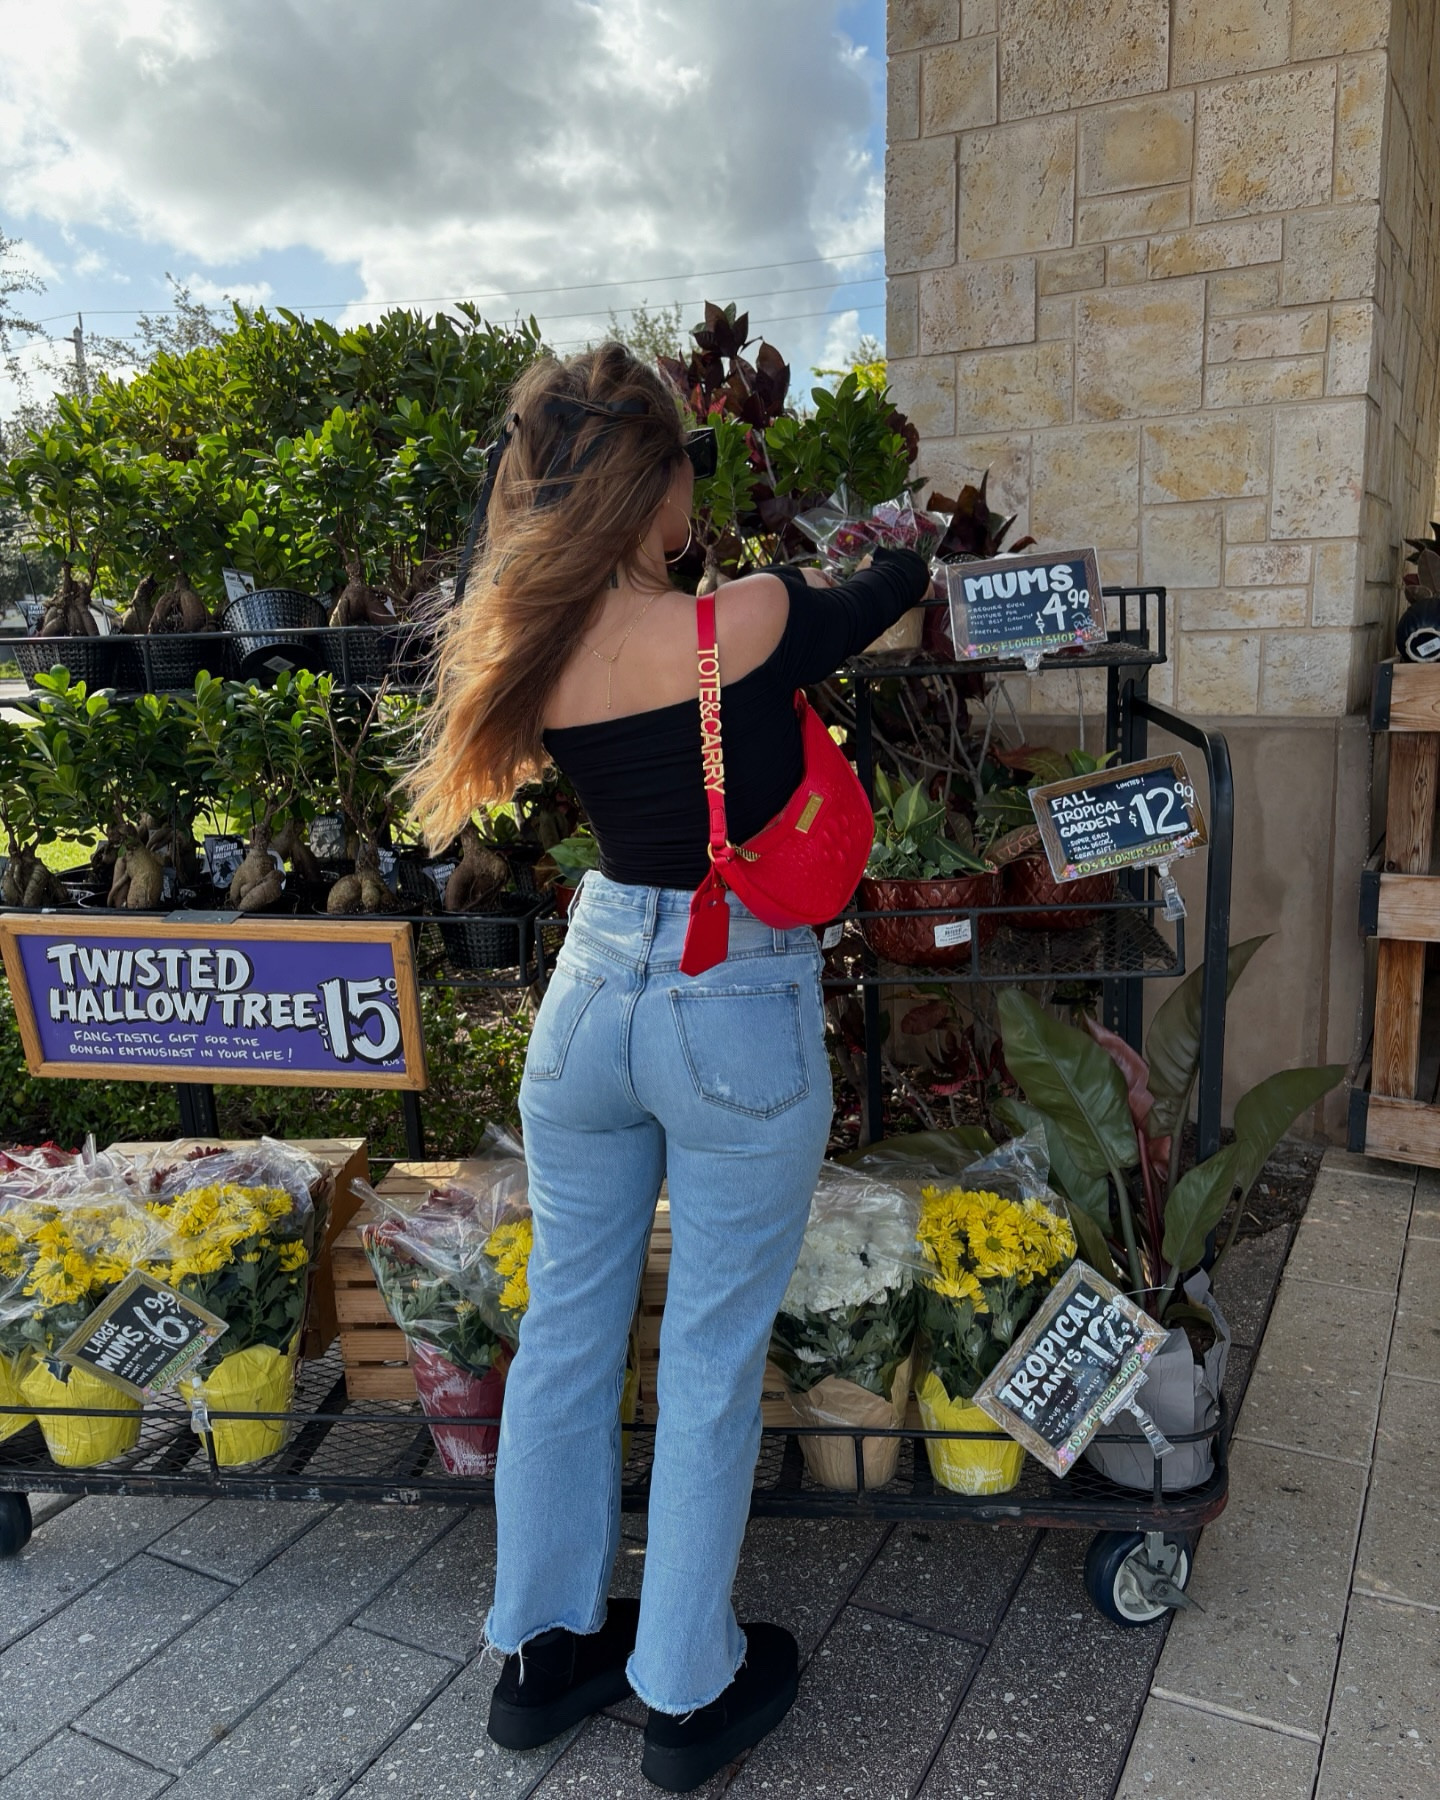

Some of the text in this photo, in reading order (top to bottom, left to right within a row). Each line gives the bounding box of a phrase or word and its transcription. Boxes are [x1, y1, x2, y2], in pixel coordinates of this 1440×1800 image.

[964, 564, 1074, 602] MUMS
[1000, 635, 1043, 651] FLOWER
[1045, 631, 1076, 645] SHOP
[697, 643, 726, 795] TOTE&CARRY
[1051, 790, 1096, 811] FALL
[1052, 800, 1125, 825] TROPICAL
[1060, 812, 1121, 838] GARDEN
[1100, 848, 1144, 869] FLOWER
[46, 943, 251, 992] TWISTED
[49, 987, 318, 1030] HALLOW TREE
[69, 1044, 115, 1055] BONSAI
[118, 1046, 196, 1058] ENTHUSIAST
[200, 1048, 213, 1058] IN
[217, 1049, 248, 1059] YOUR
[73, 1030, 261, 1046] FANG-TASTIC GIFT FOR THE
[382, 1059, 400, 1067] PLUS
[84, 1320, 119, 1354] LARGE
[95, 1326, 145, 1372] MUMS
[1000, 1292, 1100, 1408] TROPICAL
[1022, 1348, 1082, 1420] PLANTS
[1083, 1385, 1120, 1429] FLOWER
[1117, 1353, 1141, 1387] SHOP
